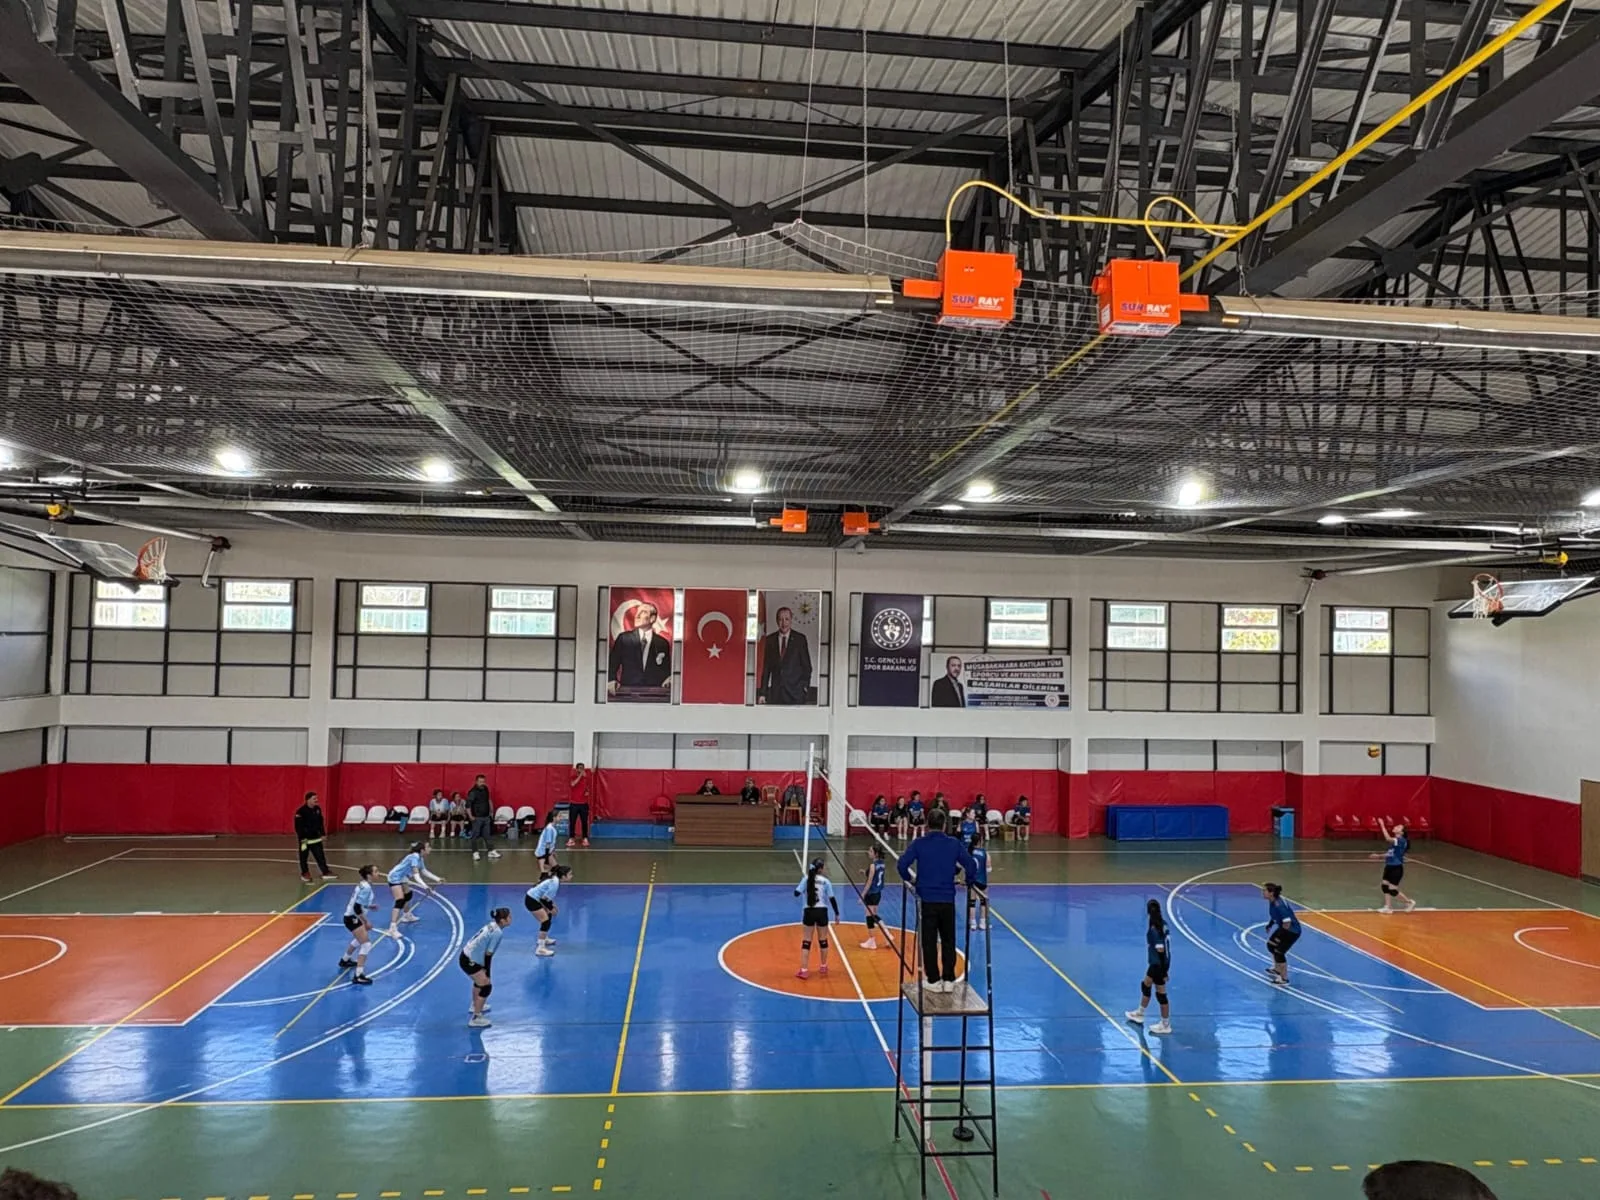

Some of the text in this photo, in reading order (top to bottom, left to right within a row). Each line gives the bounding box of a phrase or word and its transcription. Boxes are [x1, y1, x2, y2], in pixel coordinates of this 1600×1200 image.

[952, 295, 1000, 306] SUN RAY
[1121, 302, 1167, 313] SUN RAY
[864, 656, 876, 664] T.C.
[877, 656, 906, 665] GENÇLİK
[882, 664, 917, 672] BAKANLIĞI
